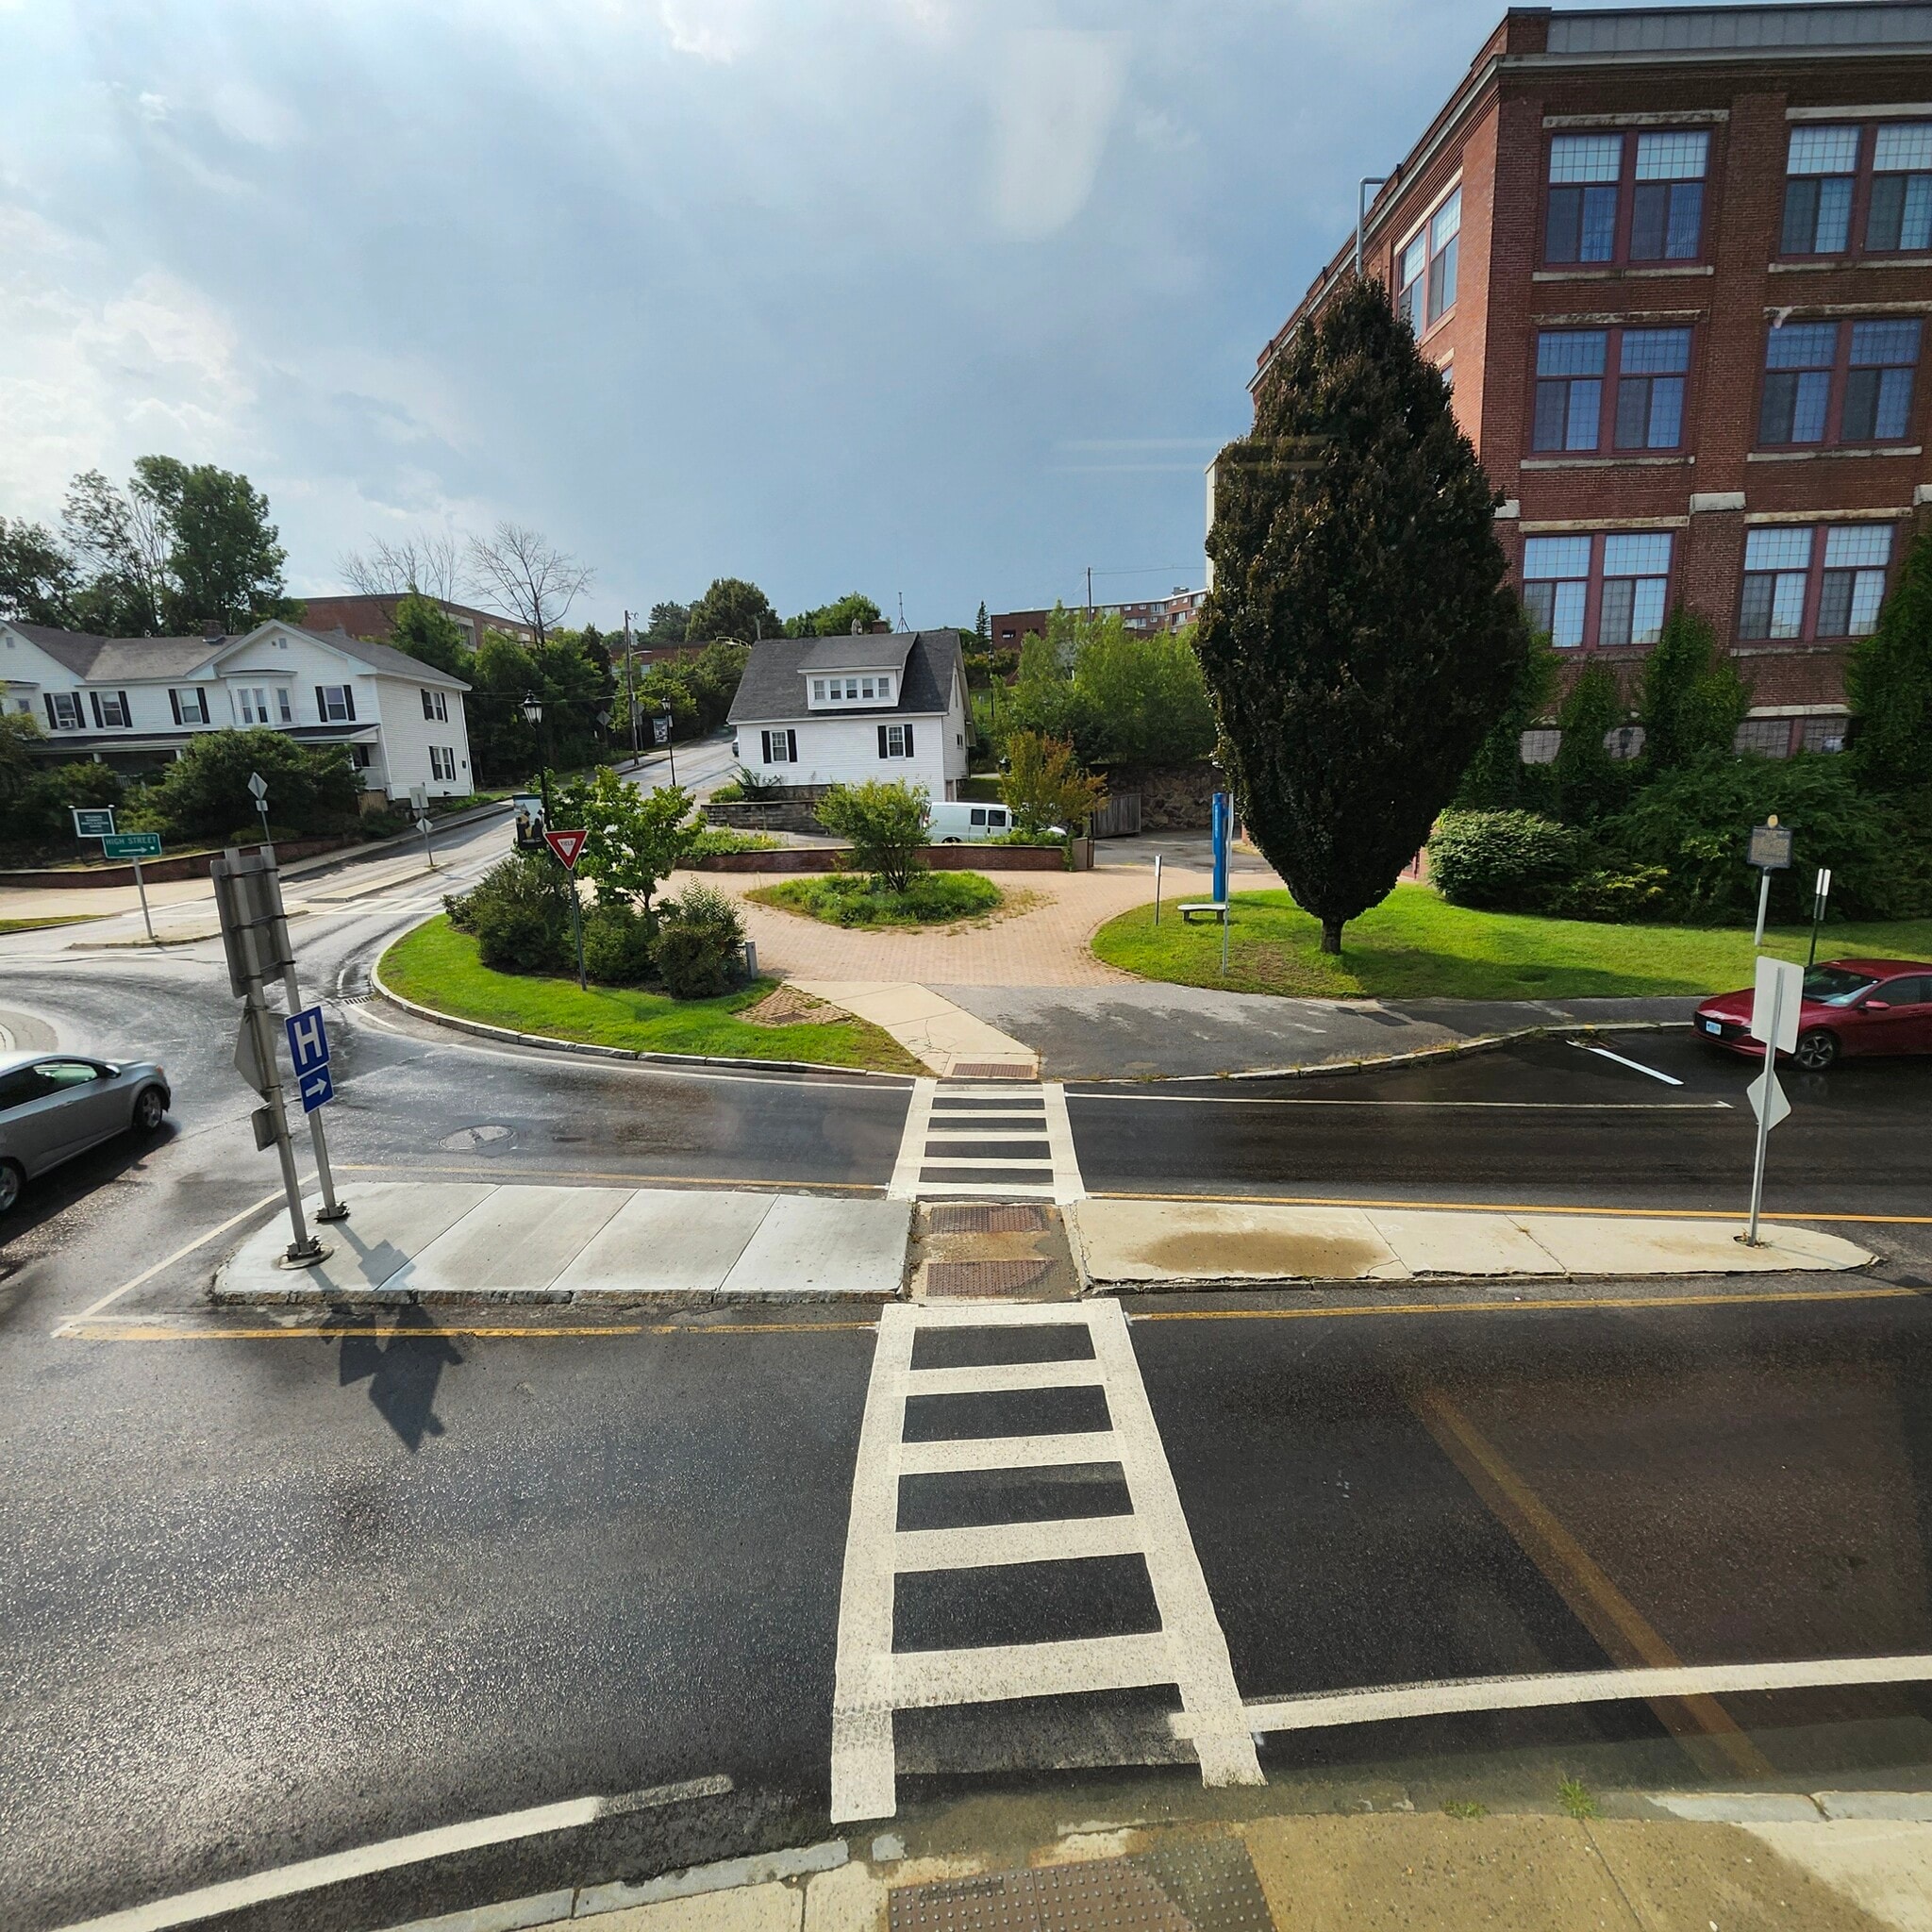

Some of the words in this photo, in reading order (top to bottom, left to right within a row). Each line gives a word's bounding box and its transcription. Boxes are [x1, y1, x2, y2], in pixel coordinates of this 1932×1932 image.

[106, 838, 125, 846] HIGH
[127, 836, 157, 845] STREET
[293, 1015, 323, 1066] H
